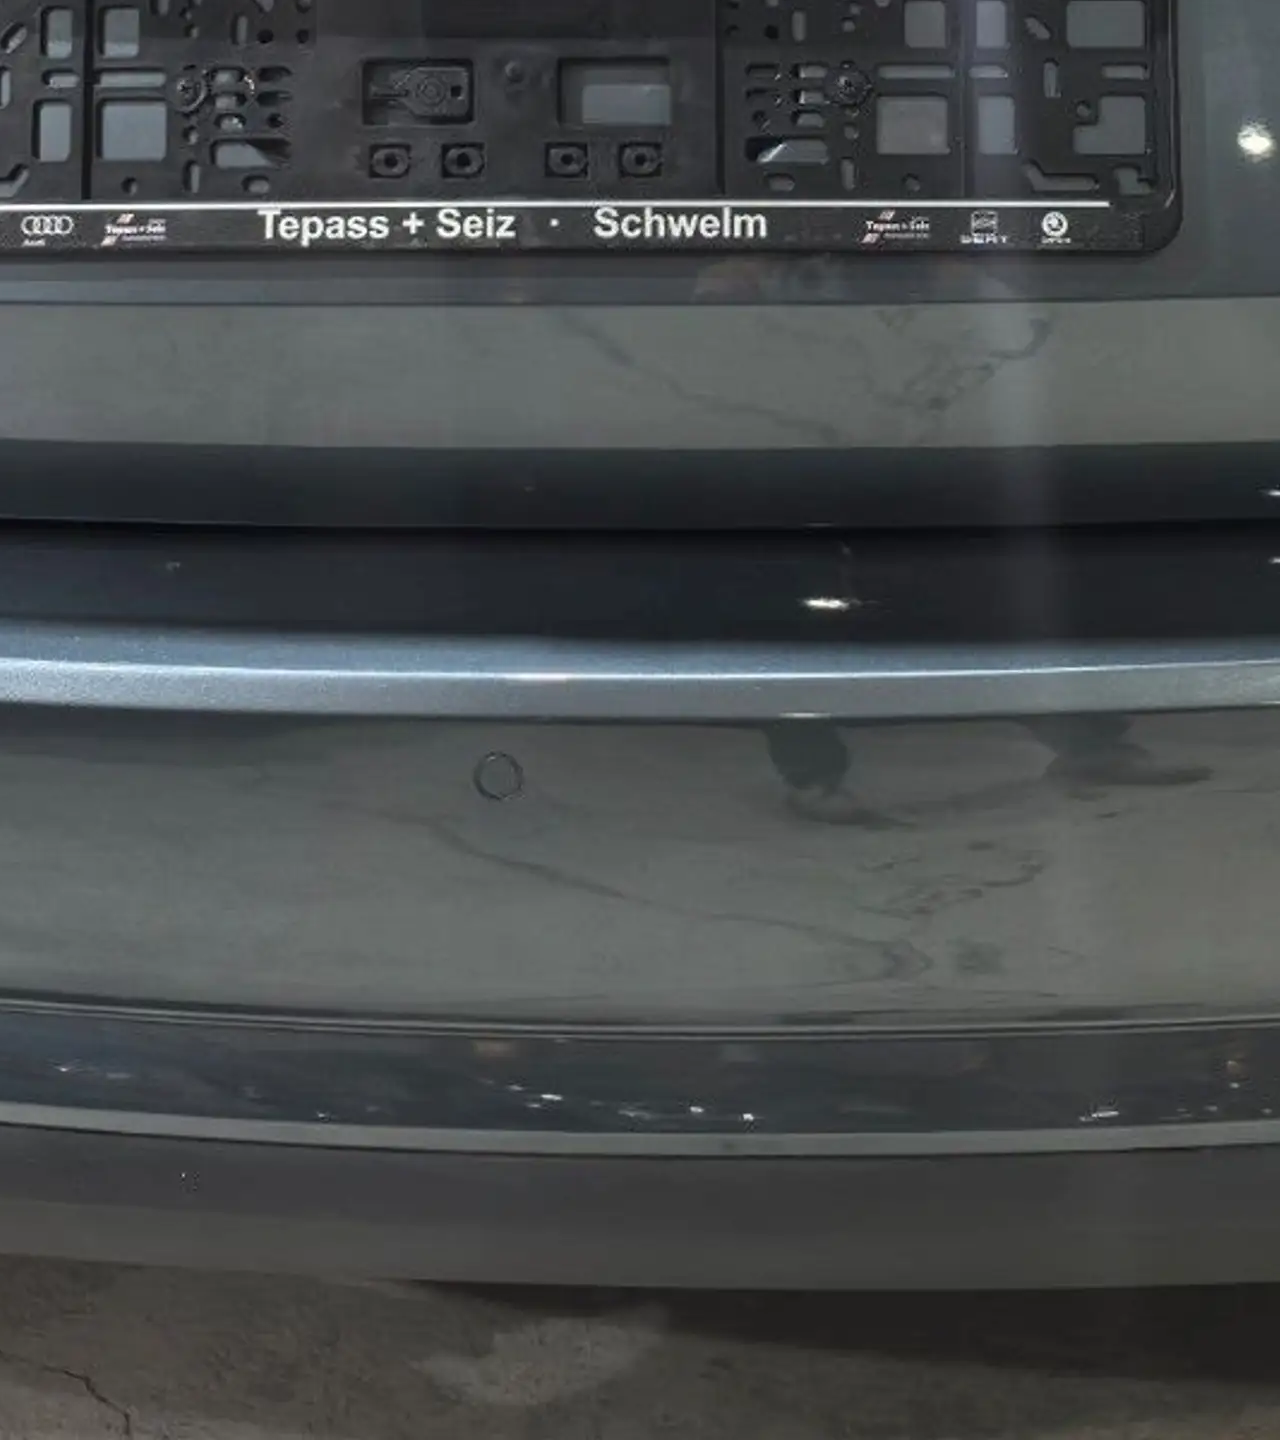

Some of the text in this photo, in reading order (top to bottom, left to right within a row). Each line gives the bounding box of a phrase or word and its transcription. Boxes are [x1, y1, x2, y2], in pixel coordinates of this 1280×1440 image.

[258, 208, 389, 246] Tepass
[402, 212, 424, 235] +
[436, 207, 516, 239] Seiz
[593, 206, 768, 239] Schwelm
